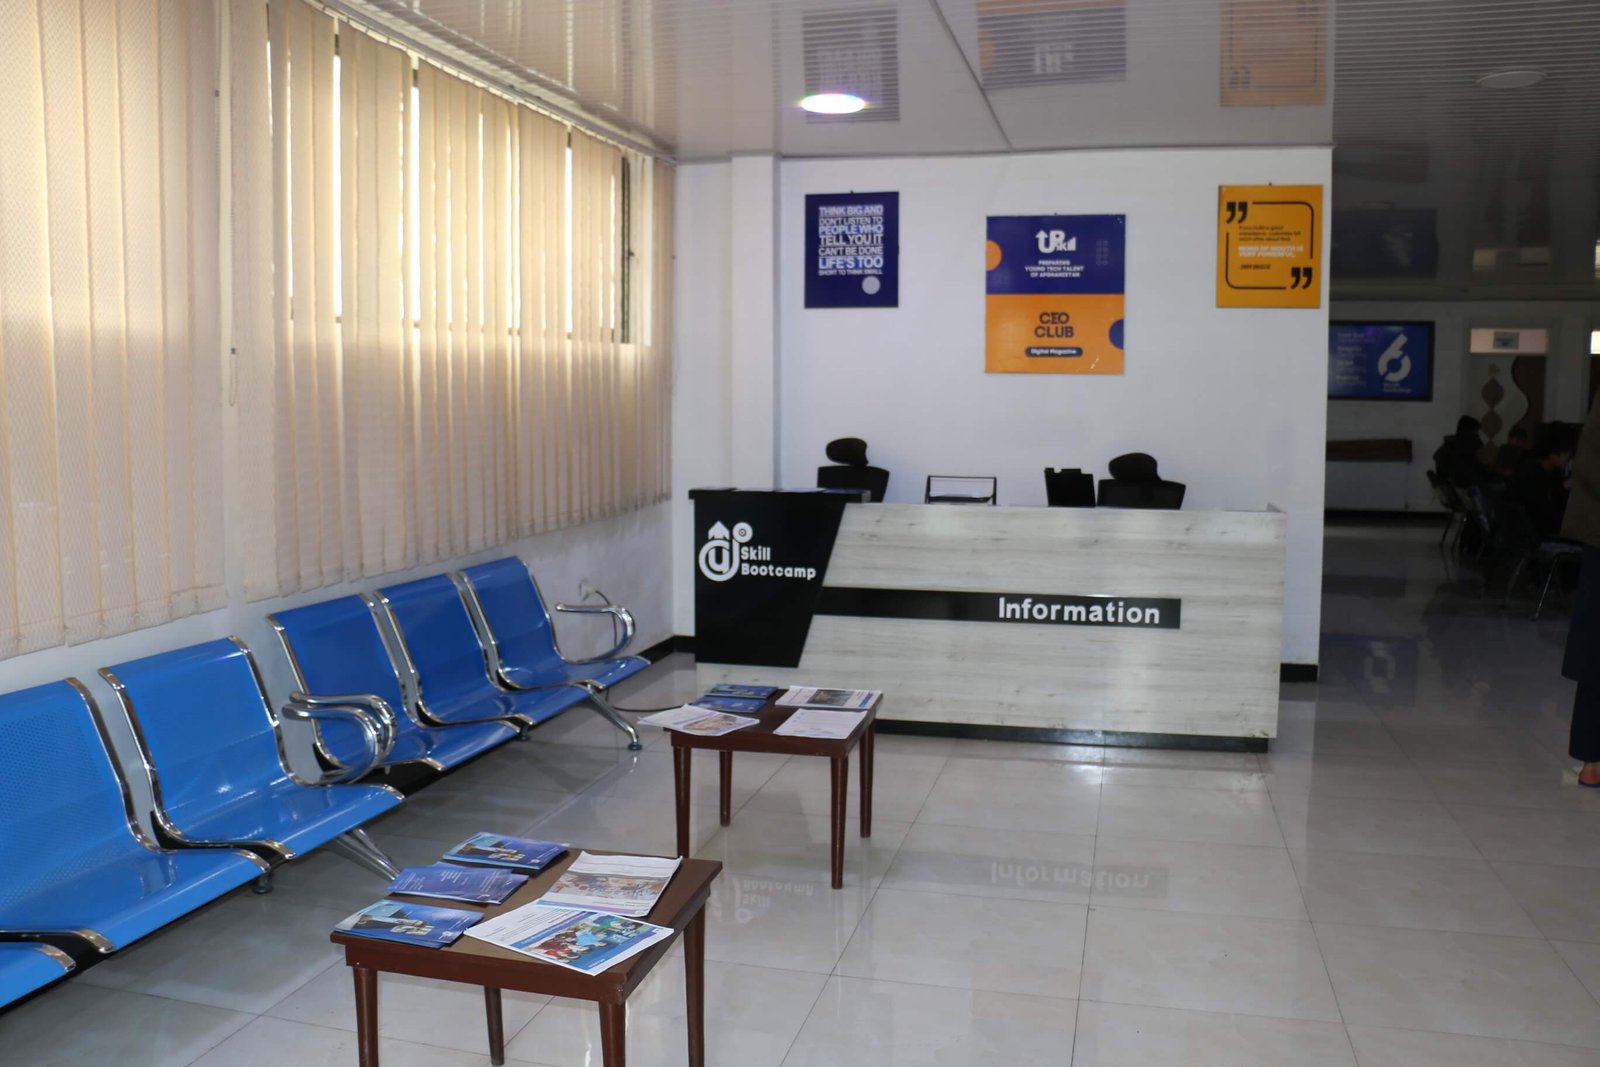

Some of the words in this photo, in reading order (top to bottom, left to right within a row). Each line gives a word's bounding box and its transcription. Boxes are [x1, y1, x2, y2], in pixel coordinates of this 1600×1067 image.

[819, 206, 846, 217] THINK
[847, 205, 862, 216] BIG
[863, 204, 883, 215] AND
[844, 217, 870, 225] LISTEN
[872, 216, 883, 224] TO
[819, 225, 858, 235] PEOPLE
[859, 224, 883, 234] WHO
[819, 235, 846, 246] TELL
[847, 234, 871, 245] YOU
[872, 234, 884, 245] IT
[845, 247, 857, 255] BE
[858, 246, 884, 255] DONE
[857, 255, 883, 268] TOO
[1039, 312, 1070, 325] CEO
[1034, 326, 1074, 338] CLUB
[741, 546, 771, 561] Skill
[741, 563, 816, 581] Bootcamp
[999, 597, 1160, 624] Information
